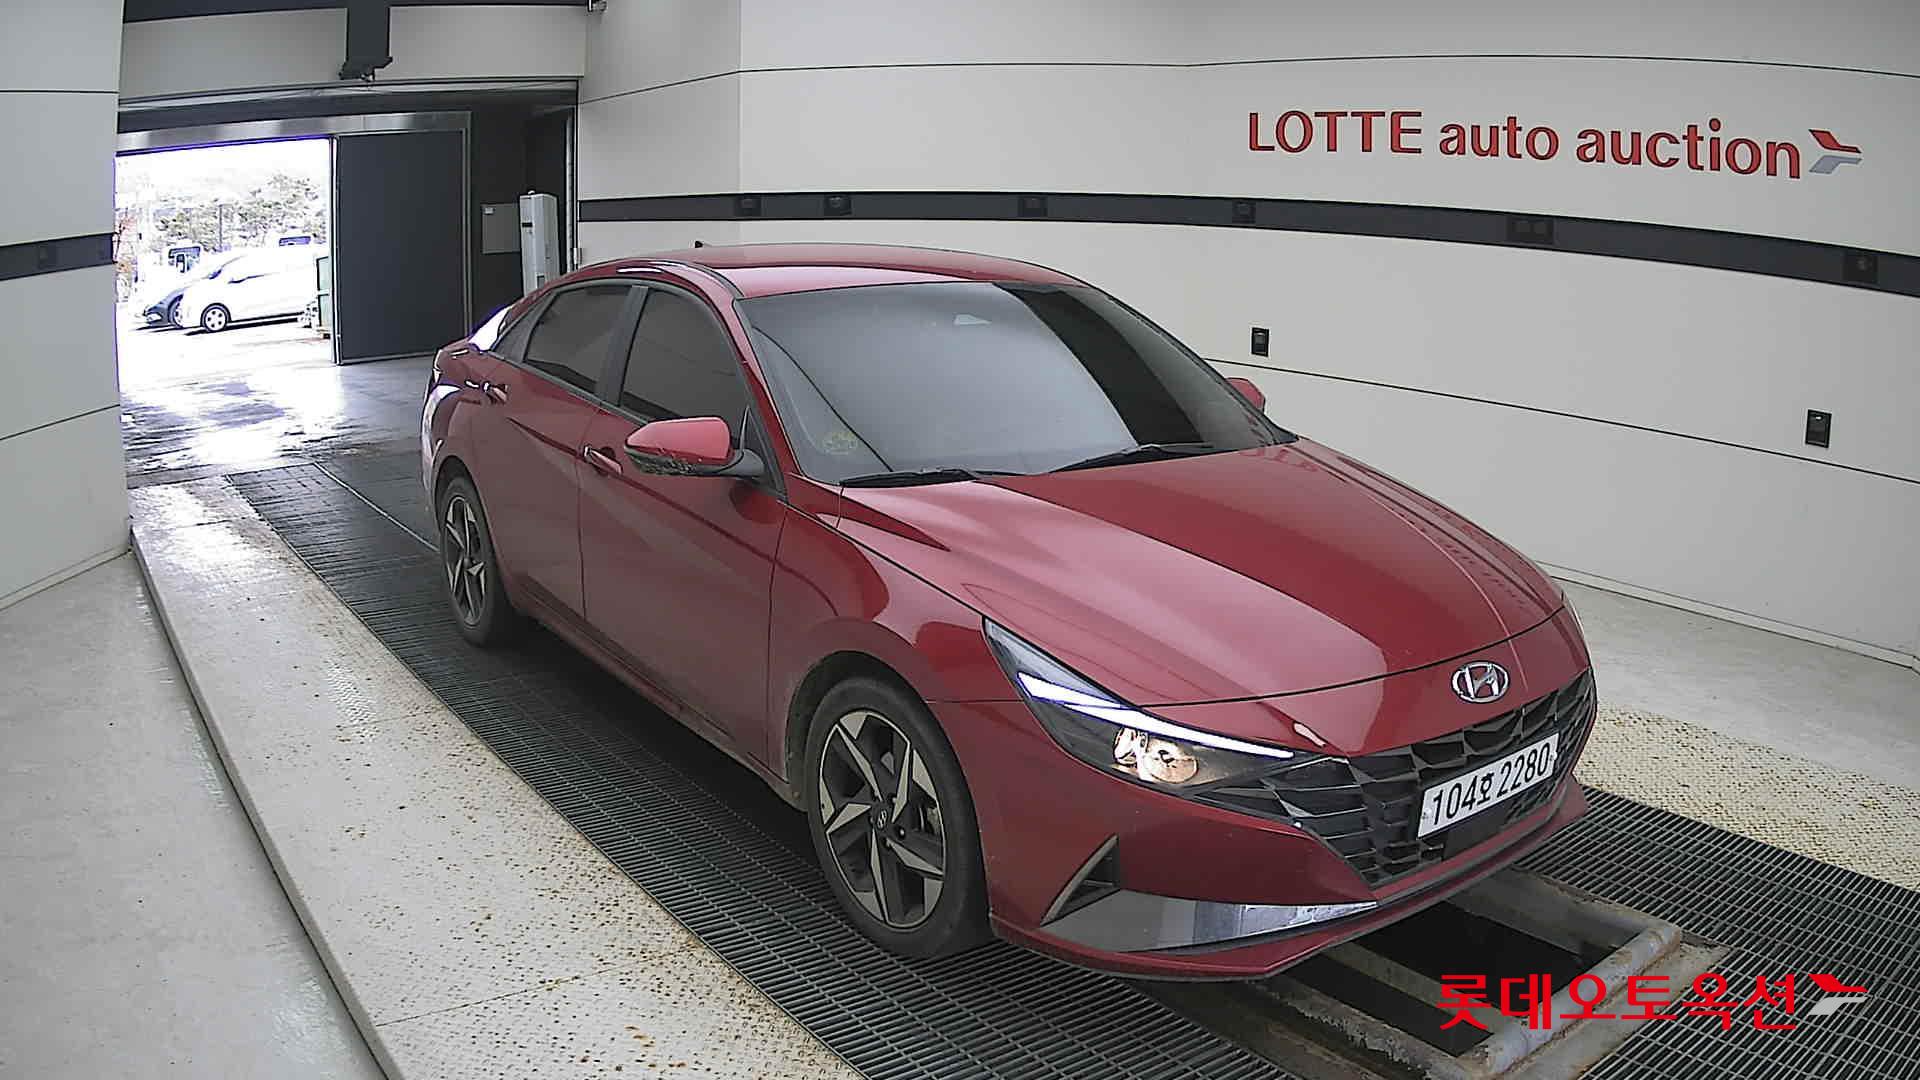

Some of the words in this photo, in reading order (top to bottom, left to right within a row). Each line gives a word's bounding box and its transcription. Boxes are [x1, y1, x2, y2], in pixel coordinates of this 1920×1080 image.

[1248, 110, 1423, 154] LOTTE
[1439, 115, 1560, 161] auto
[1576, 117, 1801, 180] auction
[1433, 771, 1495, 826] 104호
[1496, 742, 1551, 798] 2280
